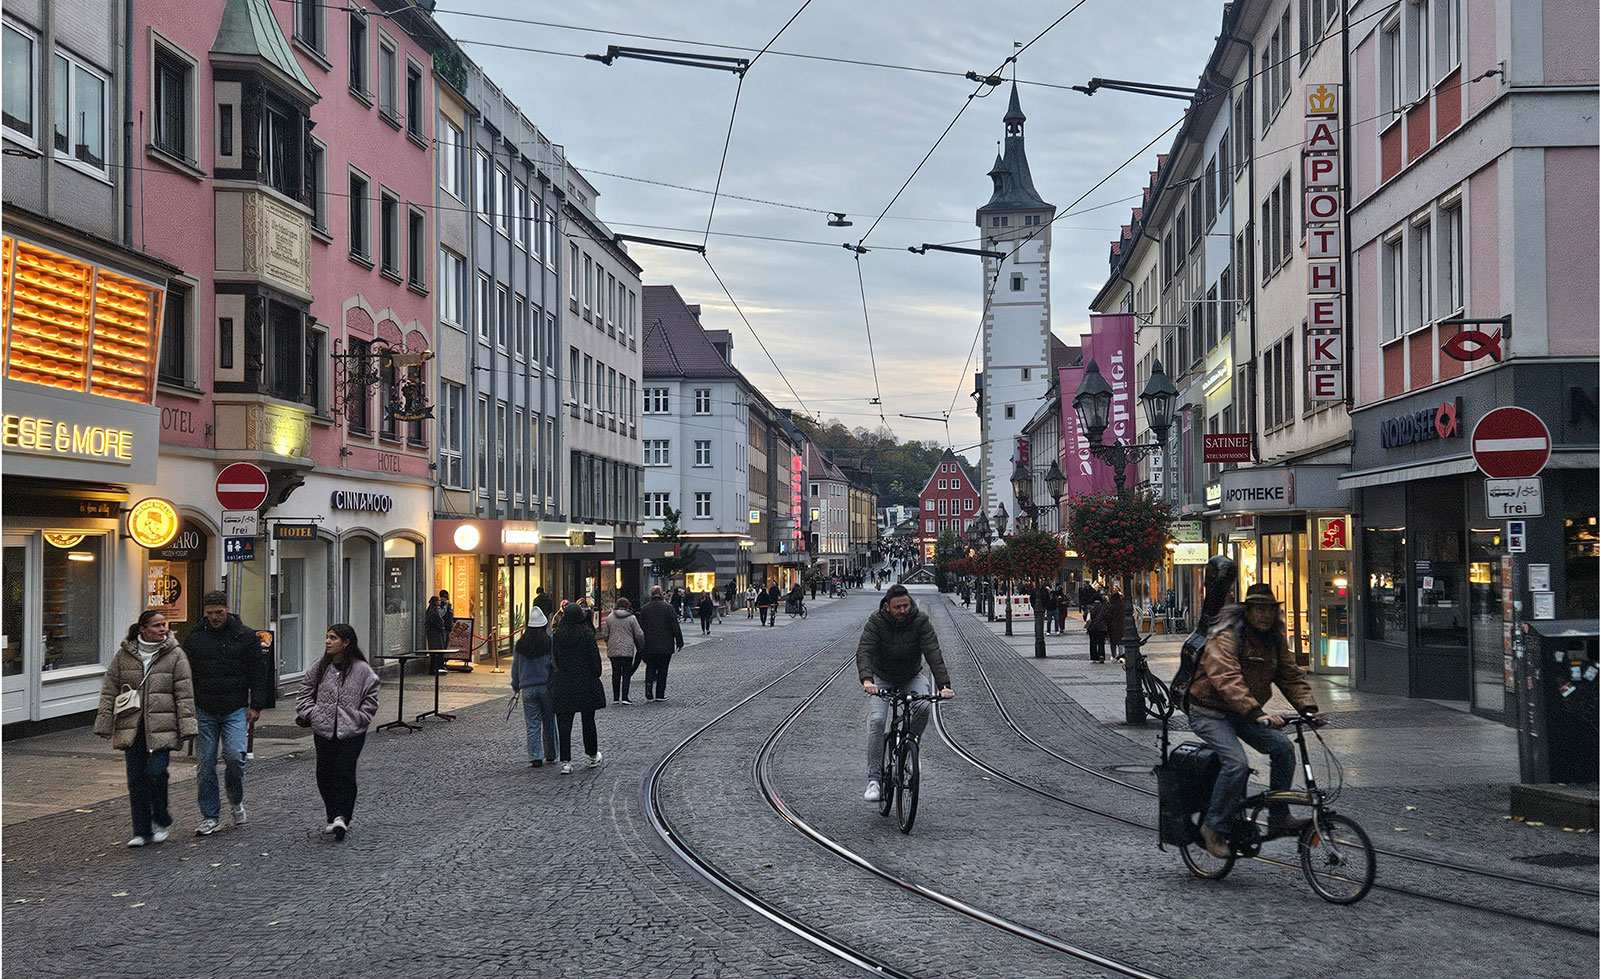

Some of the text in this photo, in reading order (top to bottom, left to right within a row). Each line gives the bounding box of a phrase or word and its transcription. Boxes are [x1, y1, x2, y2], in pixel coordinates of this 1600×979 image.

[1309, 122, 1338, 396] APOTHEKE
[161, 407, 196, 434] OTEL
[1381, 407, 1438, 449] NORDSEE
[54, 422, 70, 452] &
[72, 424, 133, 459] MORE
[1205, 437, 1249, 448] SATINEE
[377, 452, 401, 472] HOTEL
[1225, 486, 1285, 502] APOTHEKE
[1503, 502, 1528, 514] frei
[231, 525, 248, 535] frei
[279, 527, 312, 537] HOTEL
[158, 579, 178, 591] POP
[457, 557, 467, 600] CRUSTY
